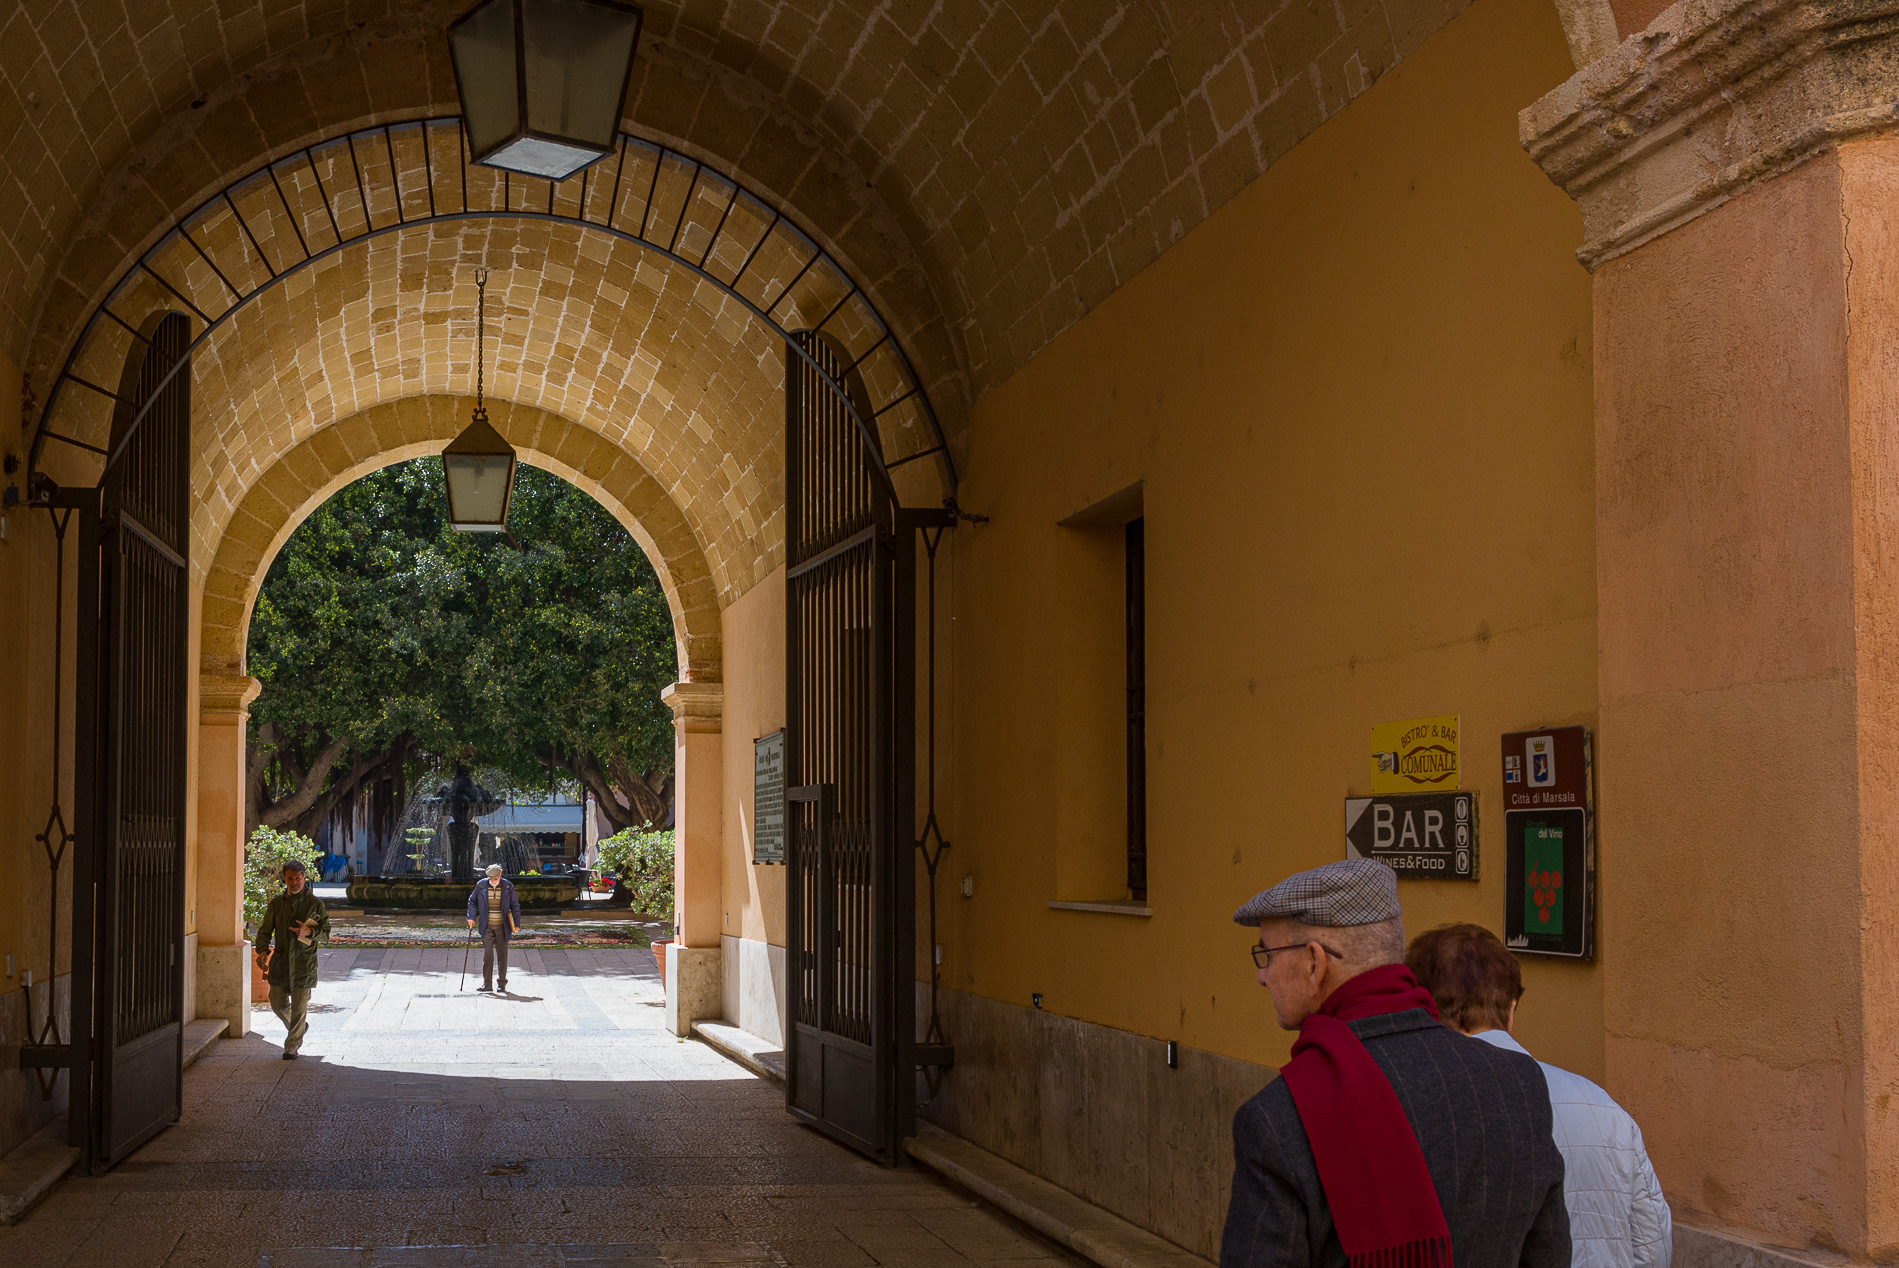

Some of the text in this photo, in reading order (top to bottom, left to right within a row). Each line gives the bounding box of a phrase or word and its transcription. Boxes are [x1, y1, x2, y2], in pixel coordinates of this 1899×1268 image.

[1432, 725, 1439, 737] &
[1441, 726, 1457, 744] BAR
[1401, 752, 1457, 774] COMUNALE
[1512, 791, 1576, 805] Città di Marsala
[1373, 804, 1445, 848] BAR
[1538, 829, 1563, 838] del Vino
